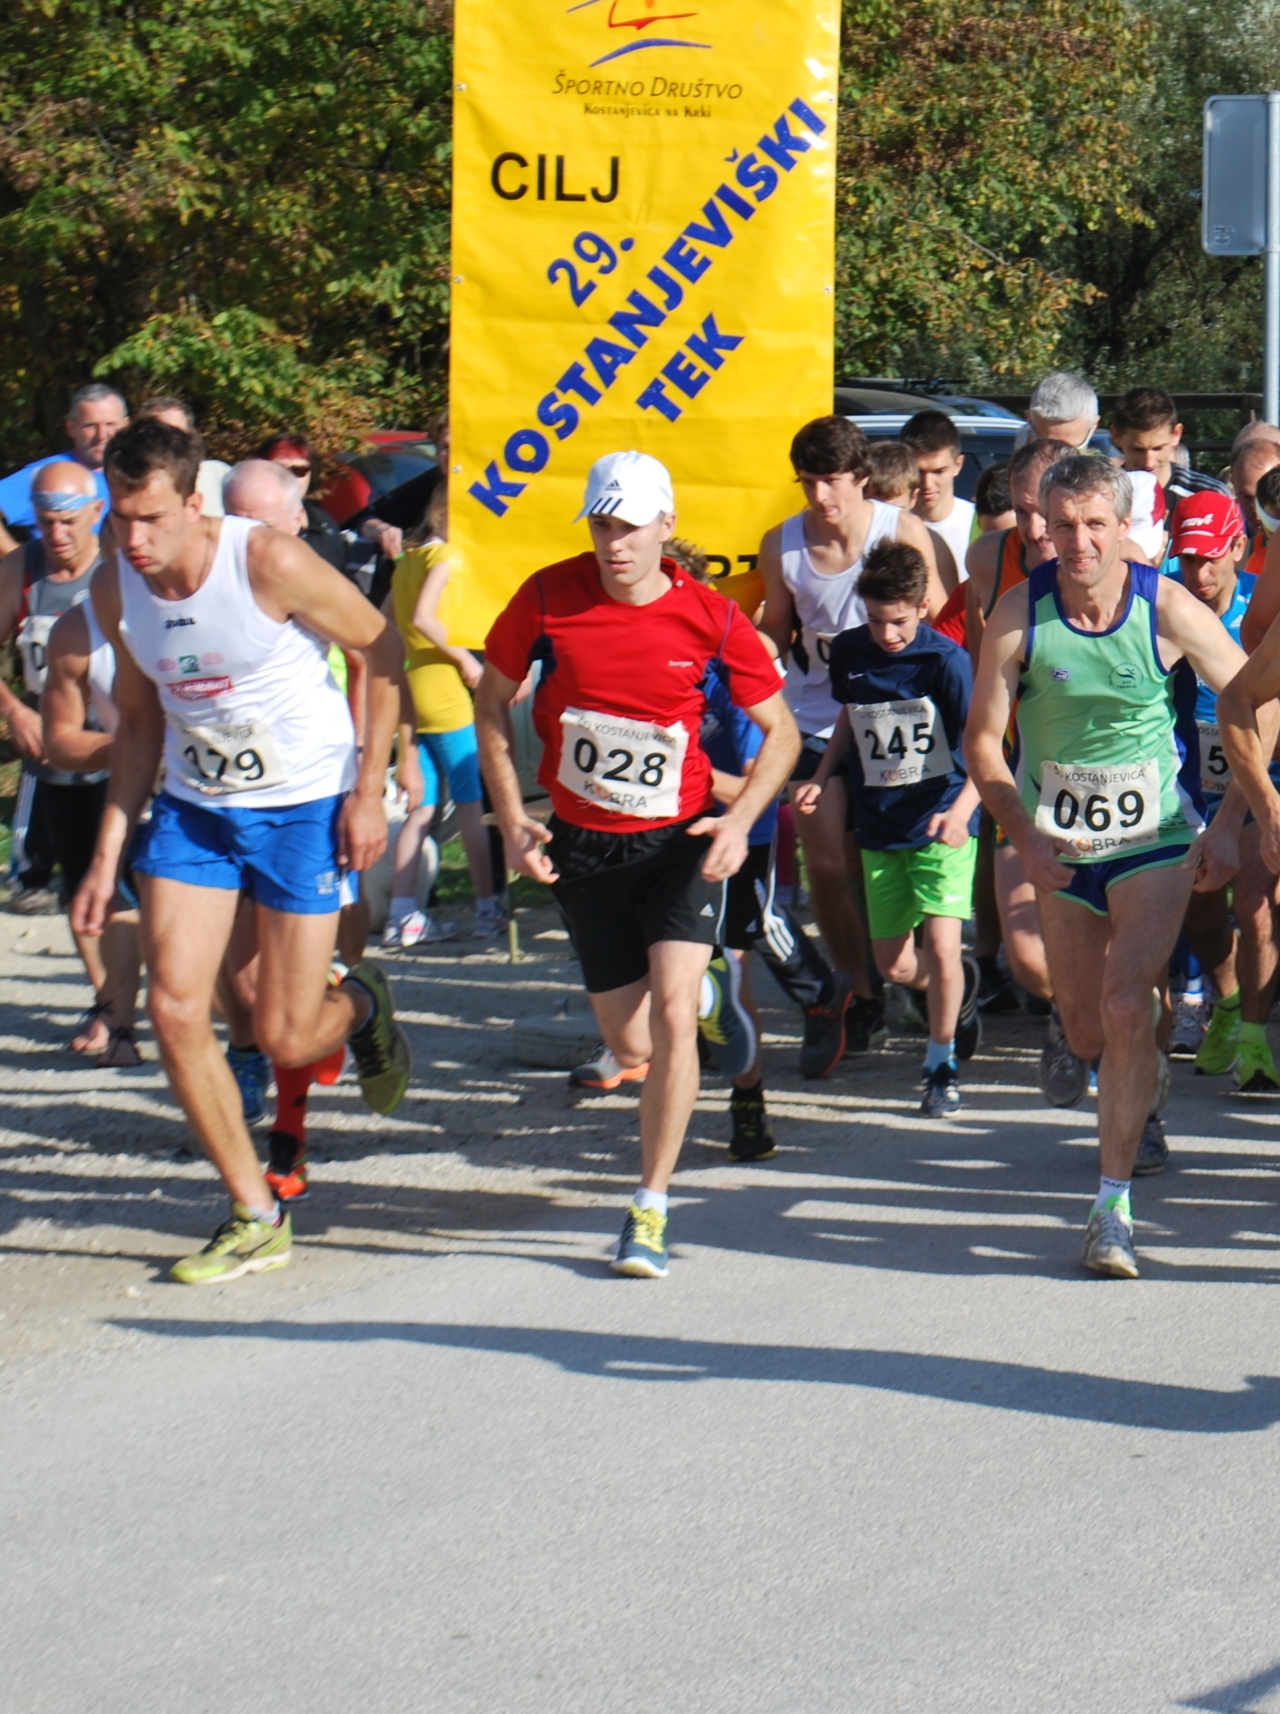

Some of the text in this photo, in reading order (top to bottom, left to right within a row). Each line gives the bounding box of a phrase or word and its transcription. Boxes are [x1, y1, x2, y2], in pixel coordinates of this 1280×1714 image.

[552, 69, 743, 99] ŠPORTNO DRUŠTVO
[491, 152, 620, 203] CILJ
[547, 231, 635, 308] 29.
[468, 97, 827, 517] KOSTANJEVIŠKI
[636, 312, 745, 422] TEK
[574, 737, 667, 787] 028
[864, 722, 936, 760] 245
[583, 780, 648, 808] KOBRA
[1065, 769, 1146, 784] KOSTANJEVICA
[1053, 788, 1145, 832] 069
